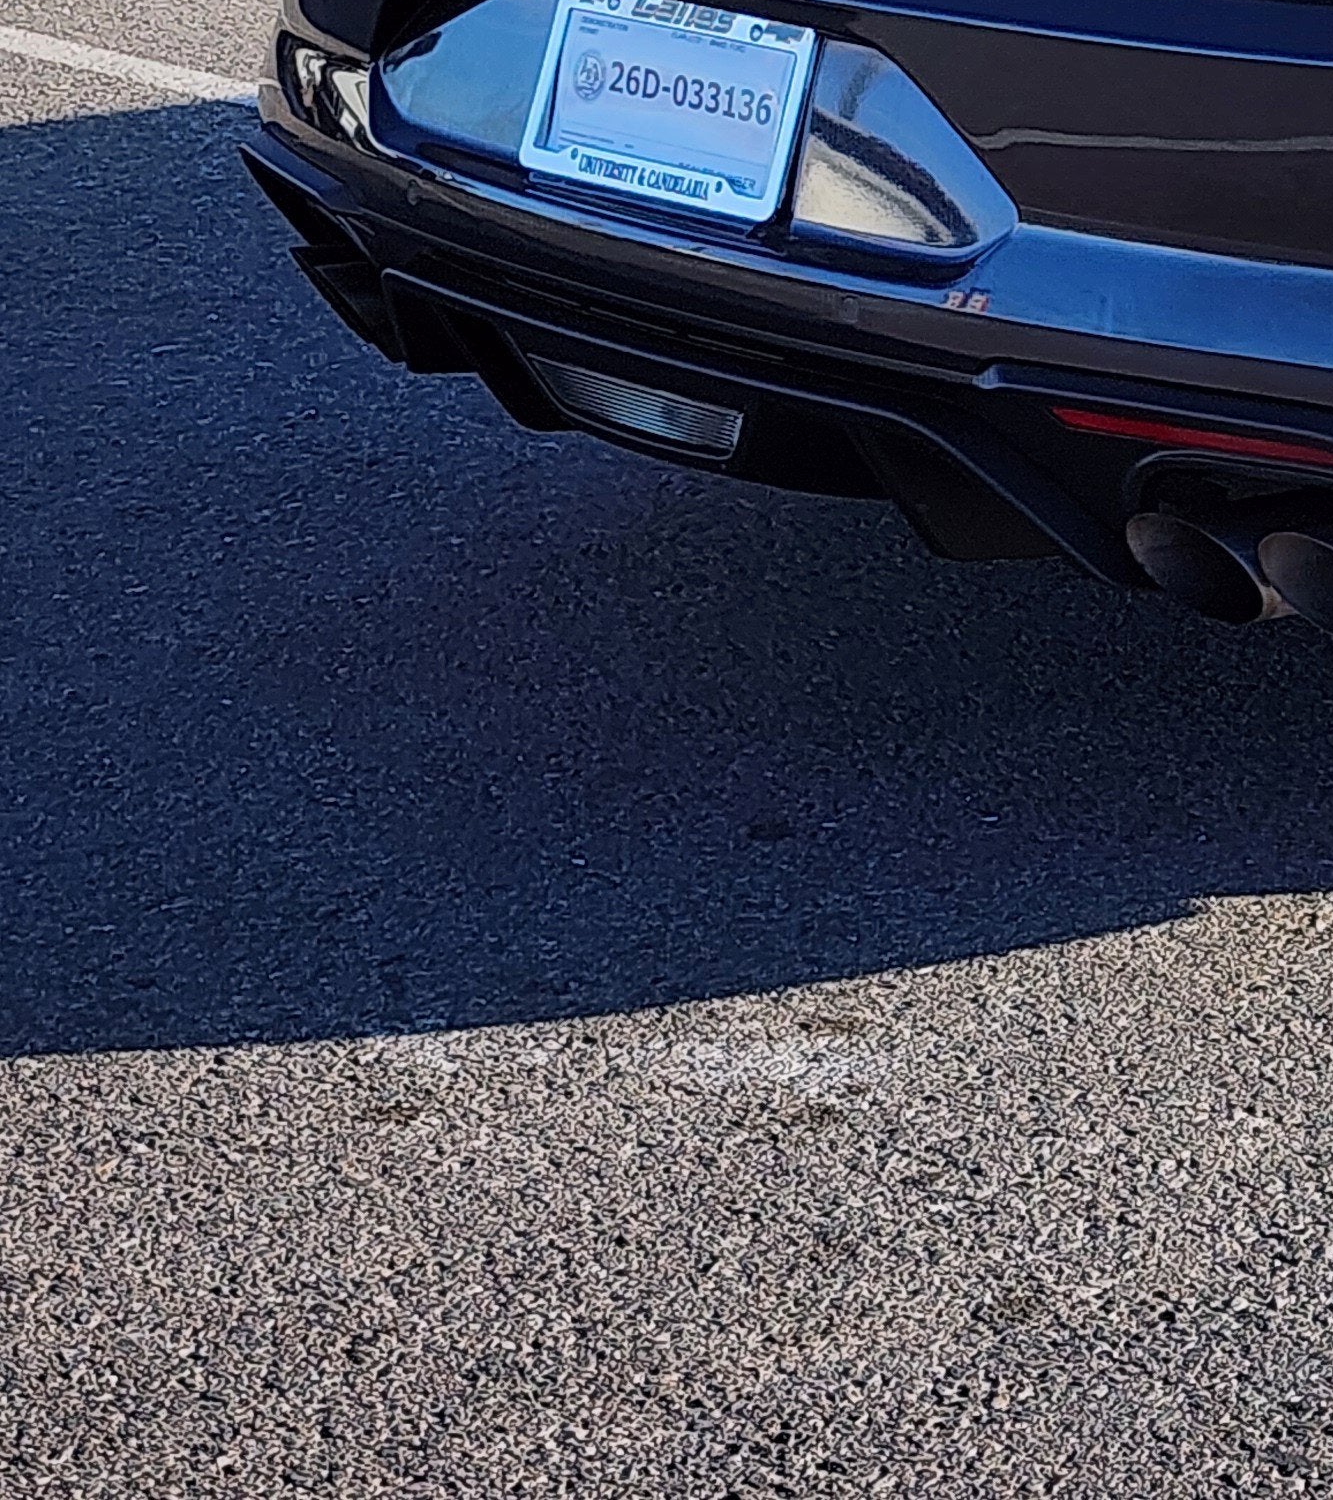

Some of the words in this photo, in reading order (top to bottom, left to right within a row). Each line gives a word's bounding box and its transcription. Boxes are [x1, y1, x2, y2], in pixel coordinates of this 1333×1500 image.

[608, 61, 773, 126] 26D-033136
[578, 153, 638, 184] UNIVERSITY
[637, 167, 647, 187] &
[647, 169, 710, 201] CANDELARIA
